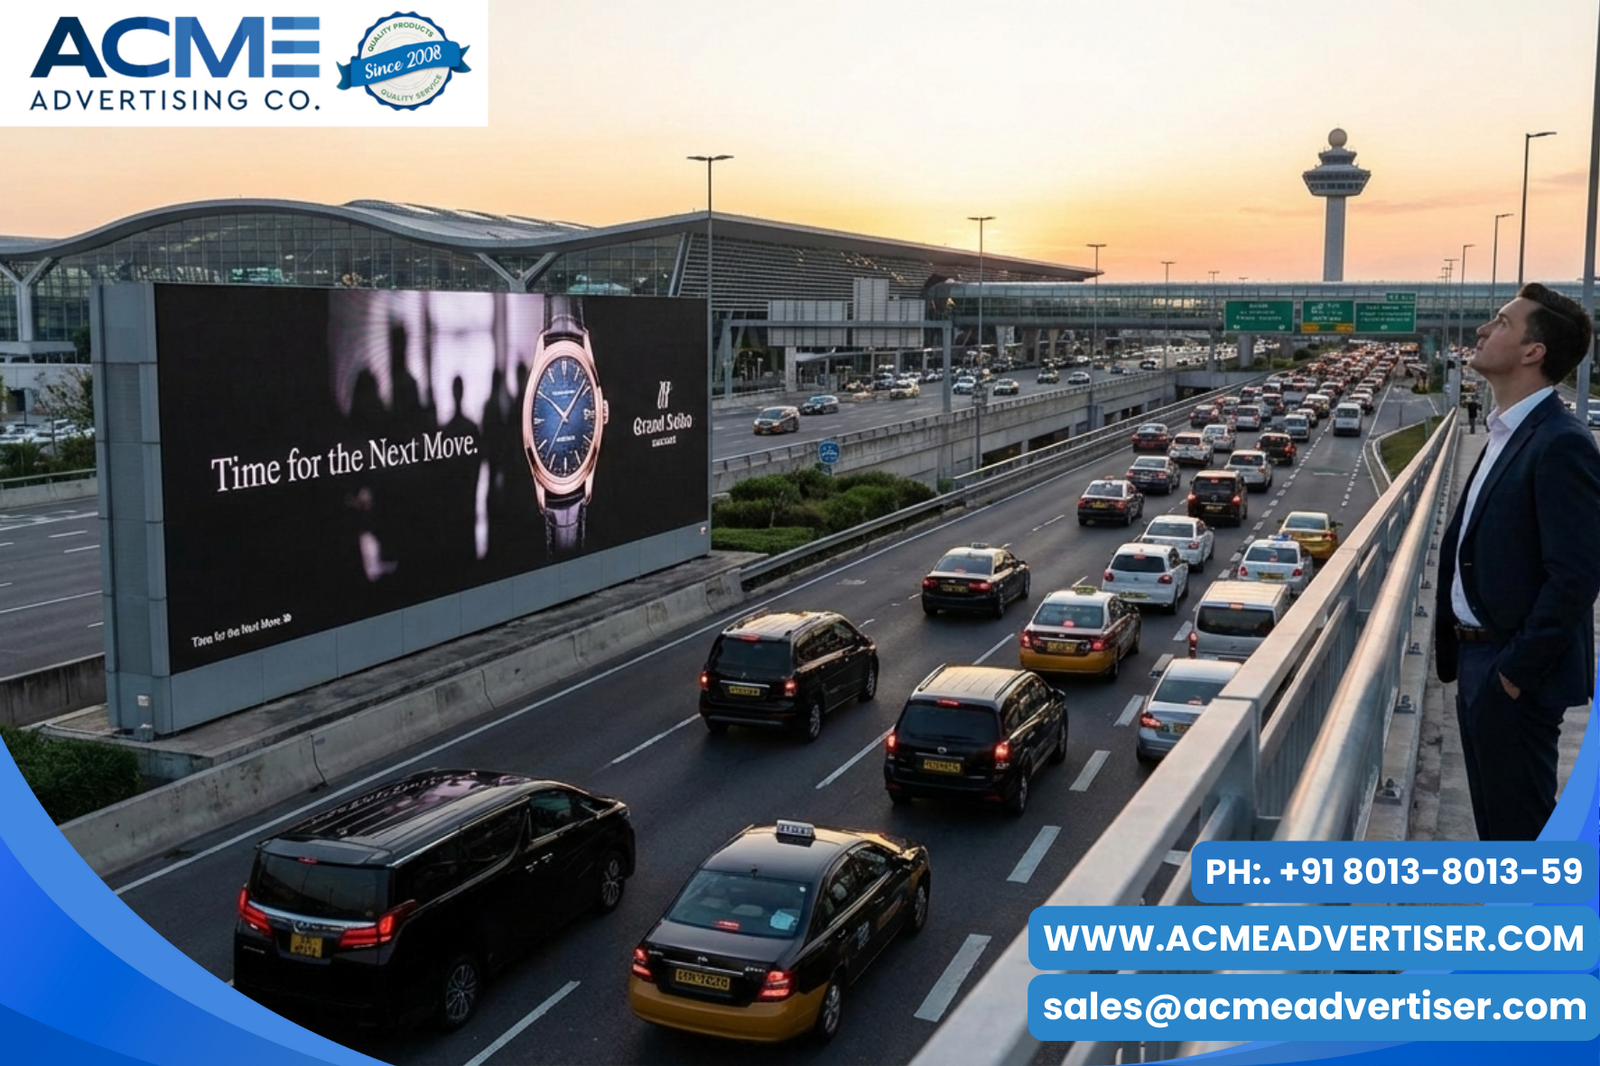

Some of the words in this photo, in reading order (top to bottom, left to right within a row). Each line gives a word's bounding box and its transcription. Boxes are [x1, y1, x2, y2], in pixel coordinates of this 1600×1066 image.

[211, 456, 281, 492] Time
[287, 448, 322, 482] for
[328, 443, 363, 475] the
[369, 438, 419, 469] Next
[423, 431, 478, 462] Move.
